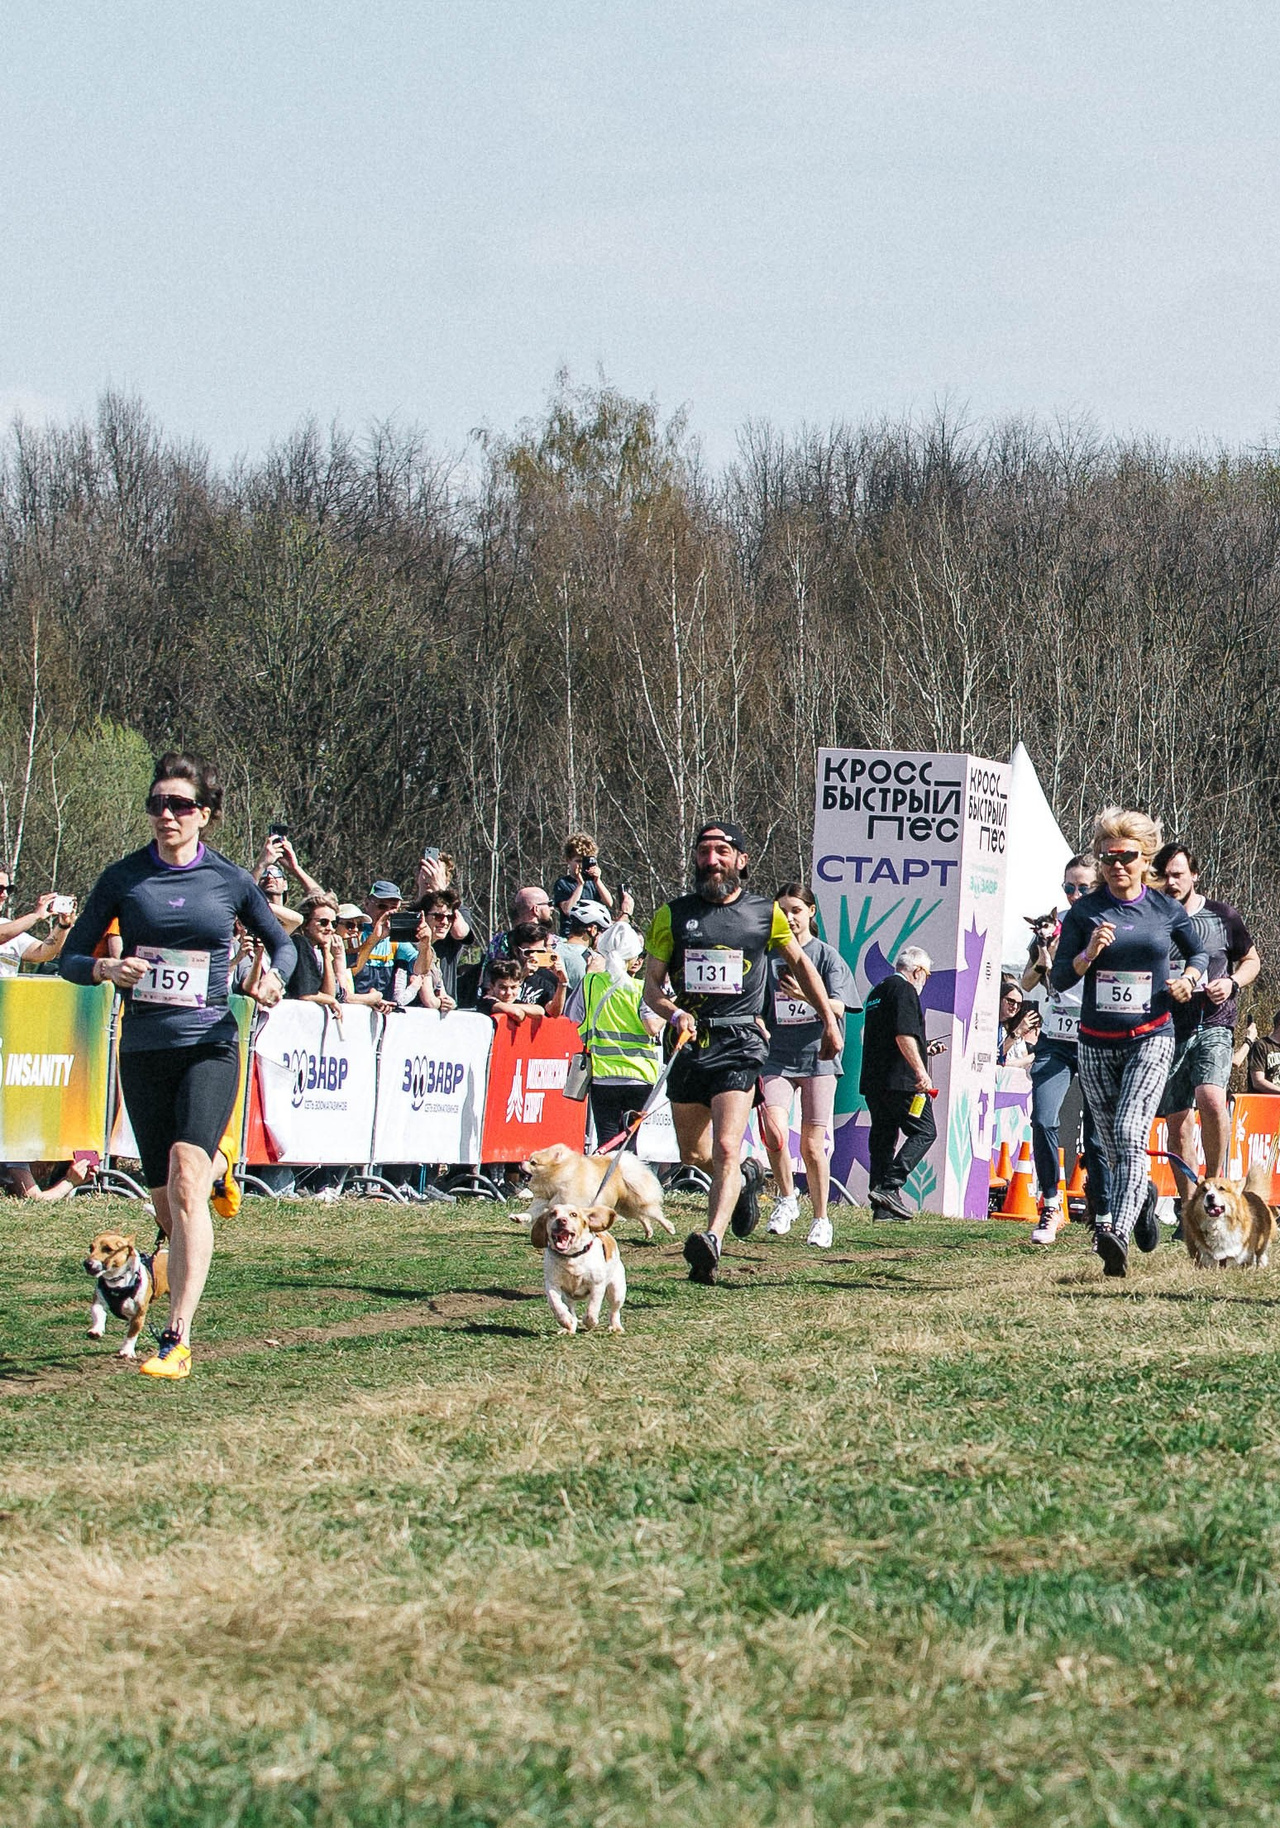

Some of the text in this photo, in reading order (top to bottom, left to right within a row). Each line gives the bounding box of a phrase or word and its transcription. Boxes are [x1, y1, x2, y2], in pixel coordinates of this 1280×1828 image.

[824, 757, 933, 787] КРОСС
[969, 767, 1001, 797] КРОСС
[822, 784, 962, 815] БЫСТРЫЙ
[816, 854, 958, 887] СТАРТ
[149, 967, 190, 991] 159
[696, 965, 726, 982] 131
[1112, 986, 1132, 1002] 56
[788, 1003, 806, 1016] 94
[1057, 1017, 1080, 1032] 191
[4, 1053, 75, 1087] INSANITY
